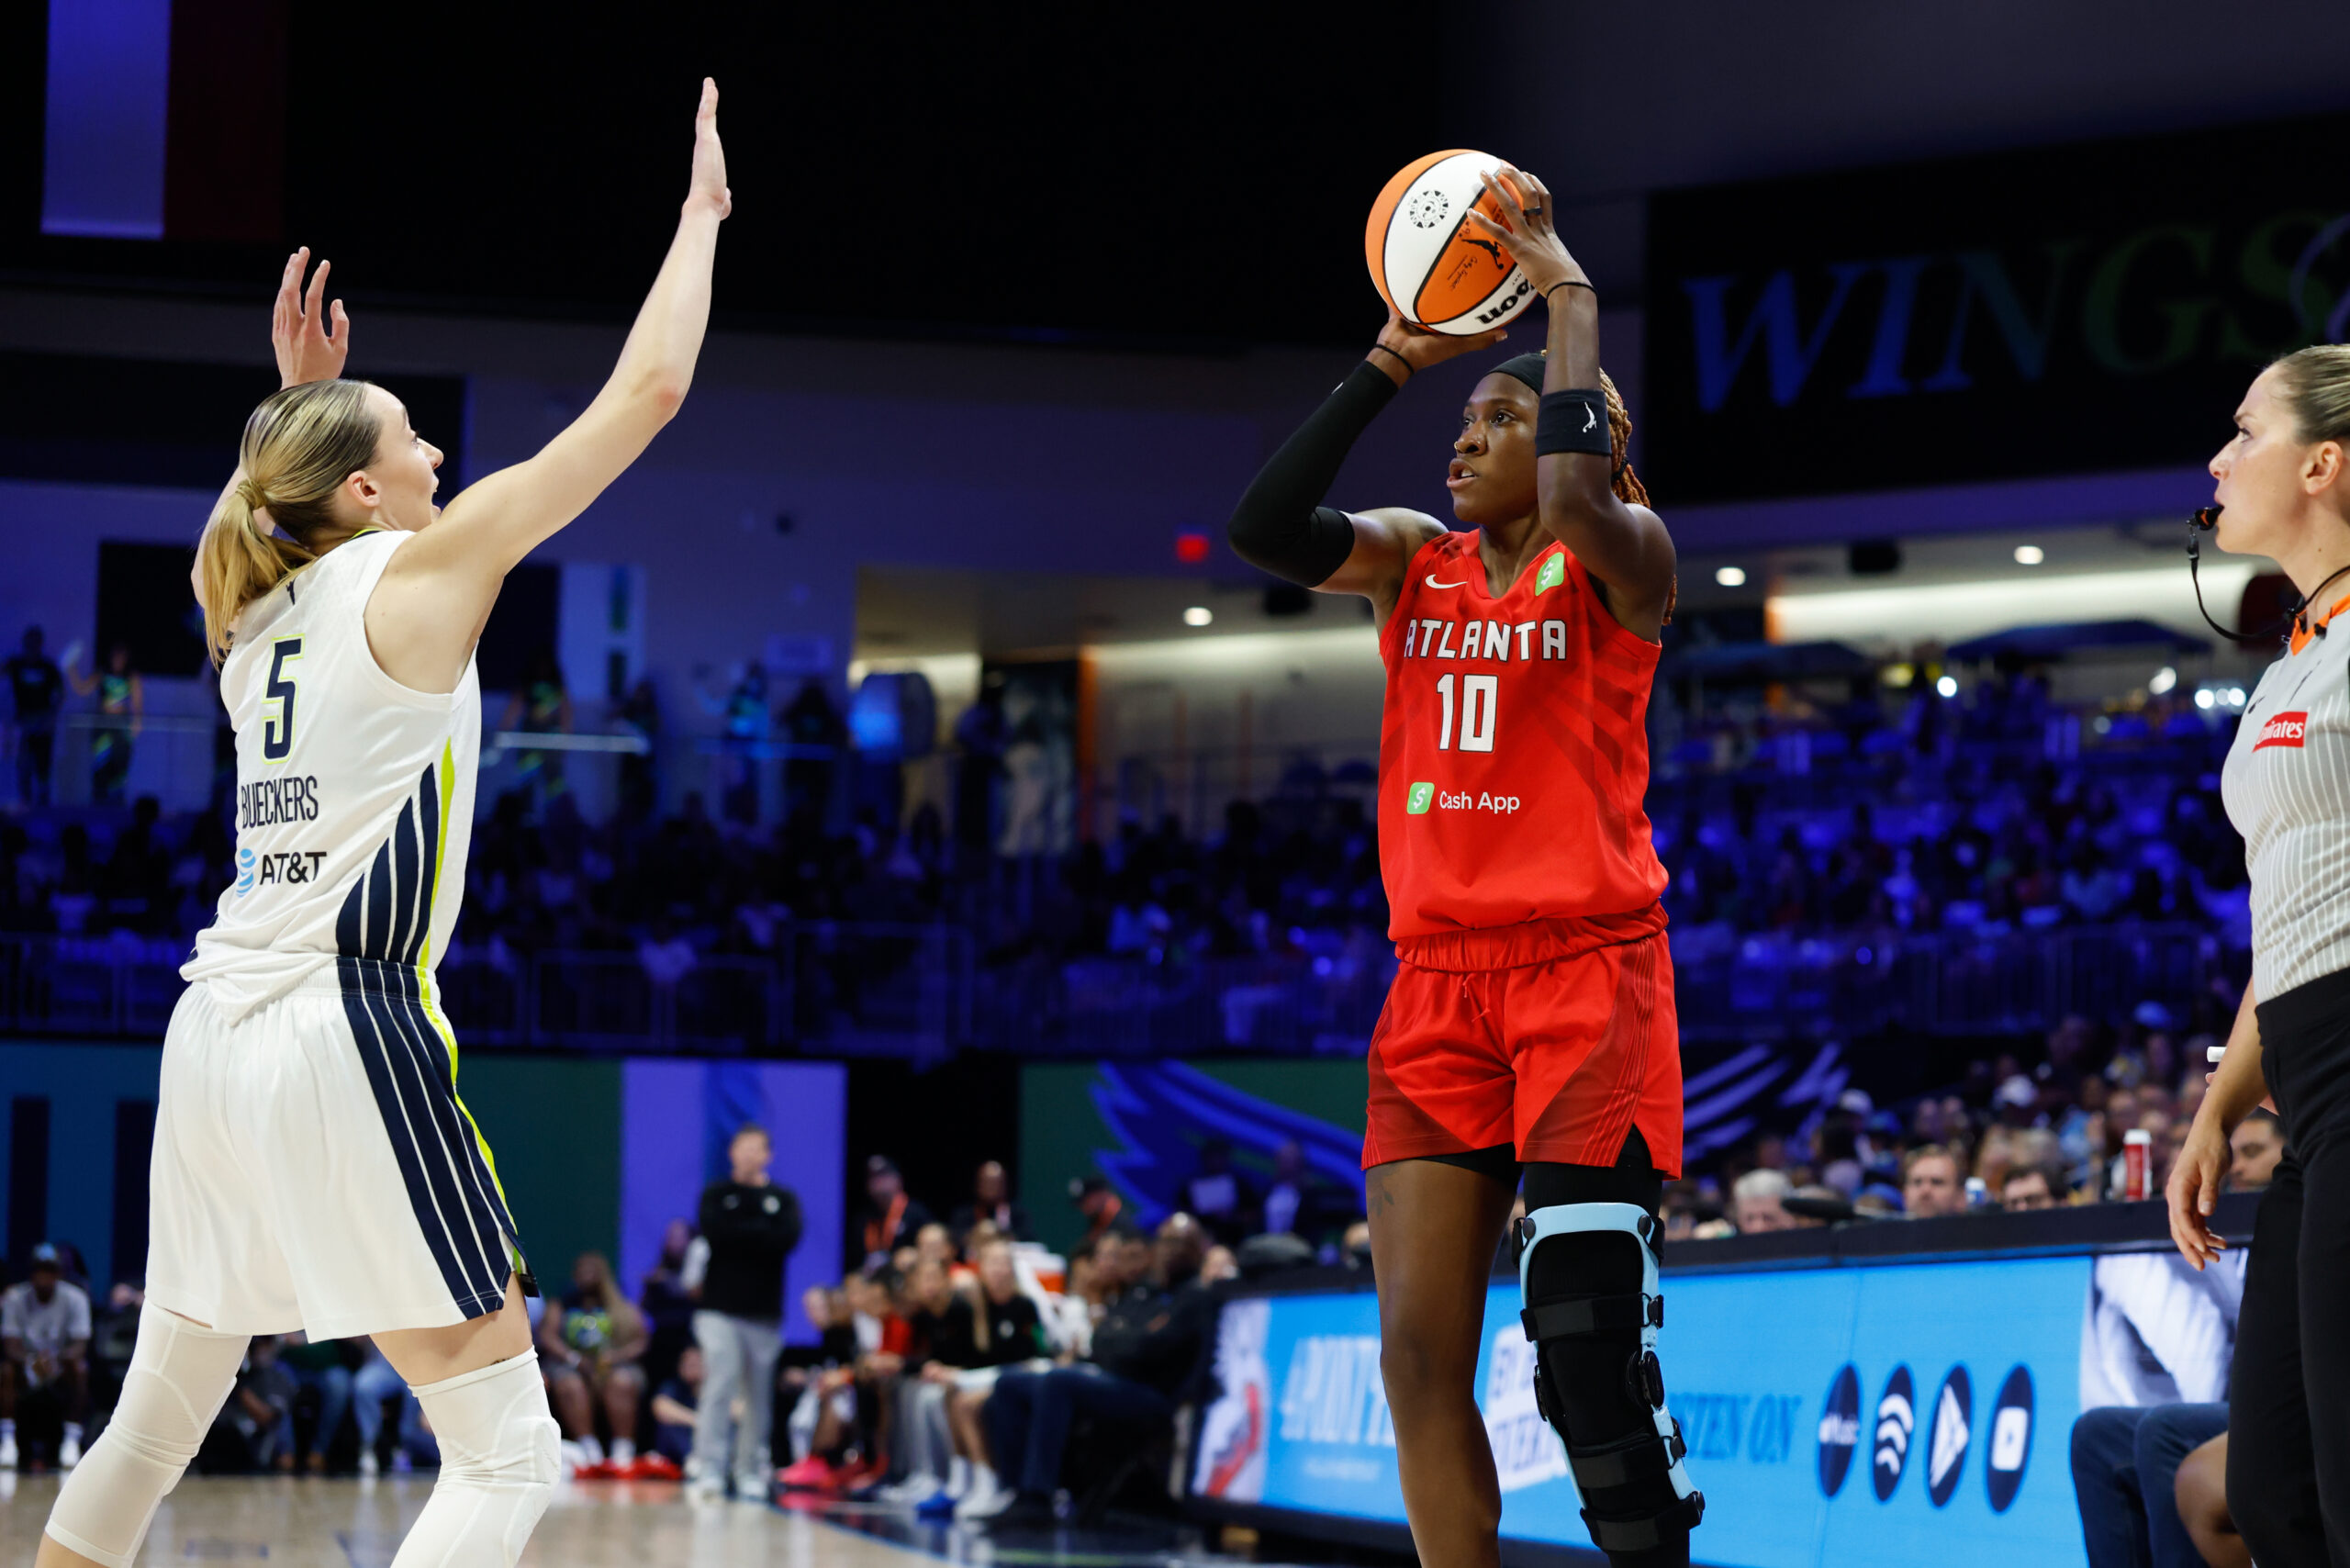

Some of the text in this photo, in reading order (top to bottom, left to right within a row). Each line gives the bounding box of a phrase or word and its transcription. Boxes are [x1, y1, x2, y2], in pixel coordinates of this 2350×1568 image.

[1404, 618, 1567, 662] ATLANTA
[262, 634, 305, 764] 5
[1437, 673, 1499, 753] 10
[241, 775, 319, 829] BUECKERS
[1439, 790, 1472, 811] Cash
[1477, 791, 1520, 814] App
[259, 851, 327, 886] AT&T
